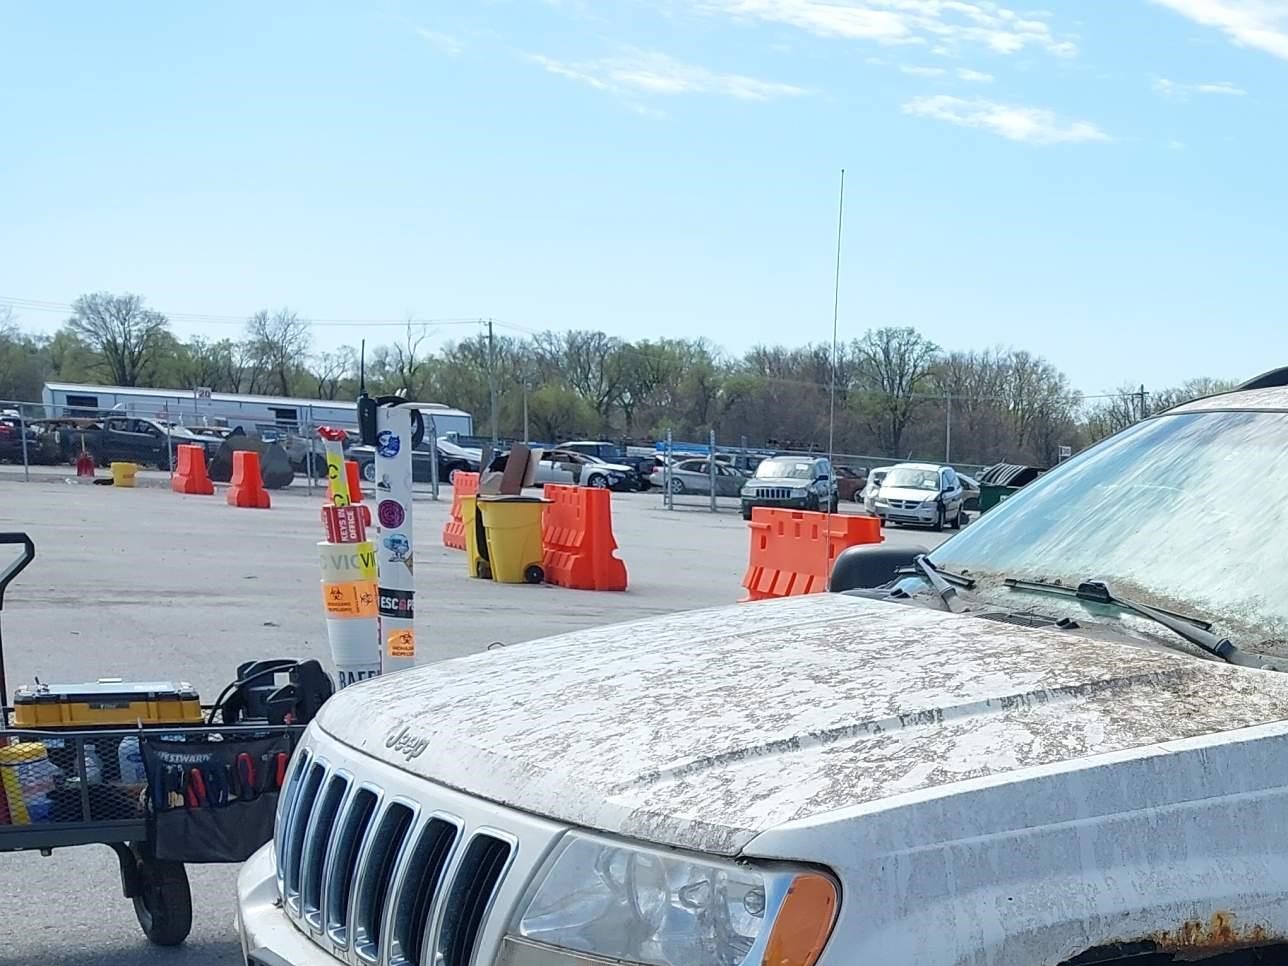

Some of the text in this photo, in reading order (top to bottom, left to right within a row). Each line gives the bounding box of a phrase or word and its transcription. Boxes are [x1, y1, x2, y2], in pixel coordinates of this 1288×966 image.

[338, 518, 349, 541] KEYS
[346, 511, 357, 540] OFFICE
[386, 726, 430, 762] Jeep
